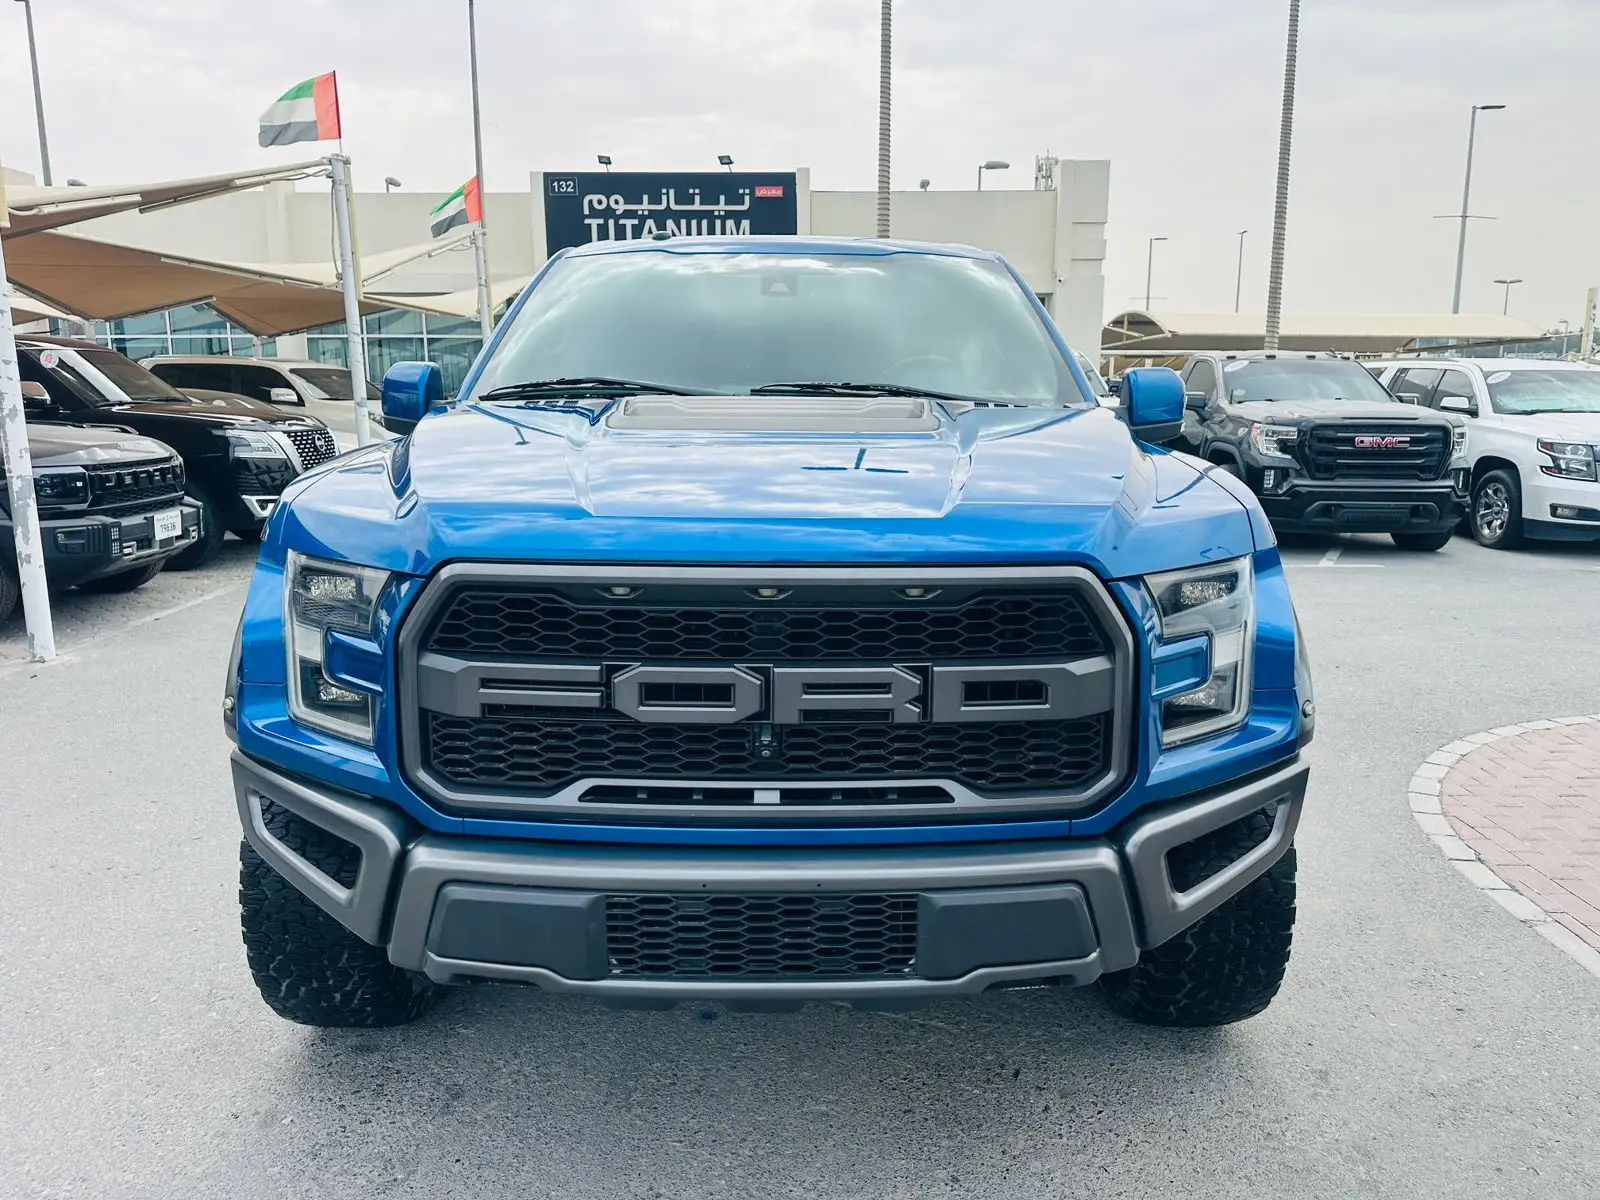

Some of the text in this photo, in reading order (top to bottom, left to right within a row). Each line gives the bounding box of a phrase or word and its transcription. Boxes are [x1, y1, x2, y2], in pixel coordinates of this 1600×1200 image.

[552, 180, 574, 192] 132
[583, 188, 750, 215] تيتانيوم
[583, 218, 750, 242] TITANIUM
[1355, 436, 1411, 448] GMC
[418, 653, 1115, 726] FORD
